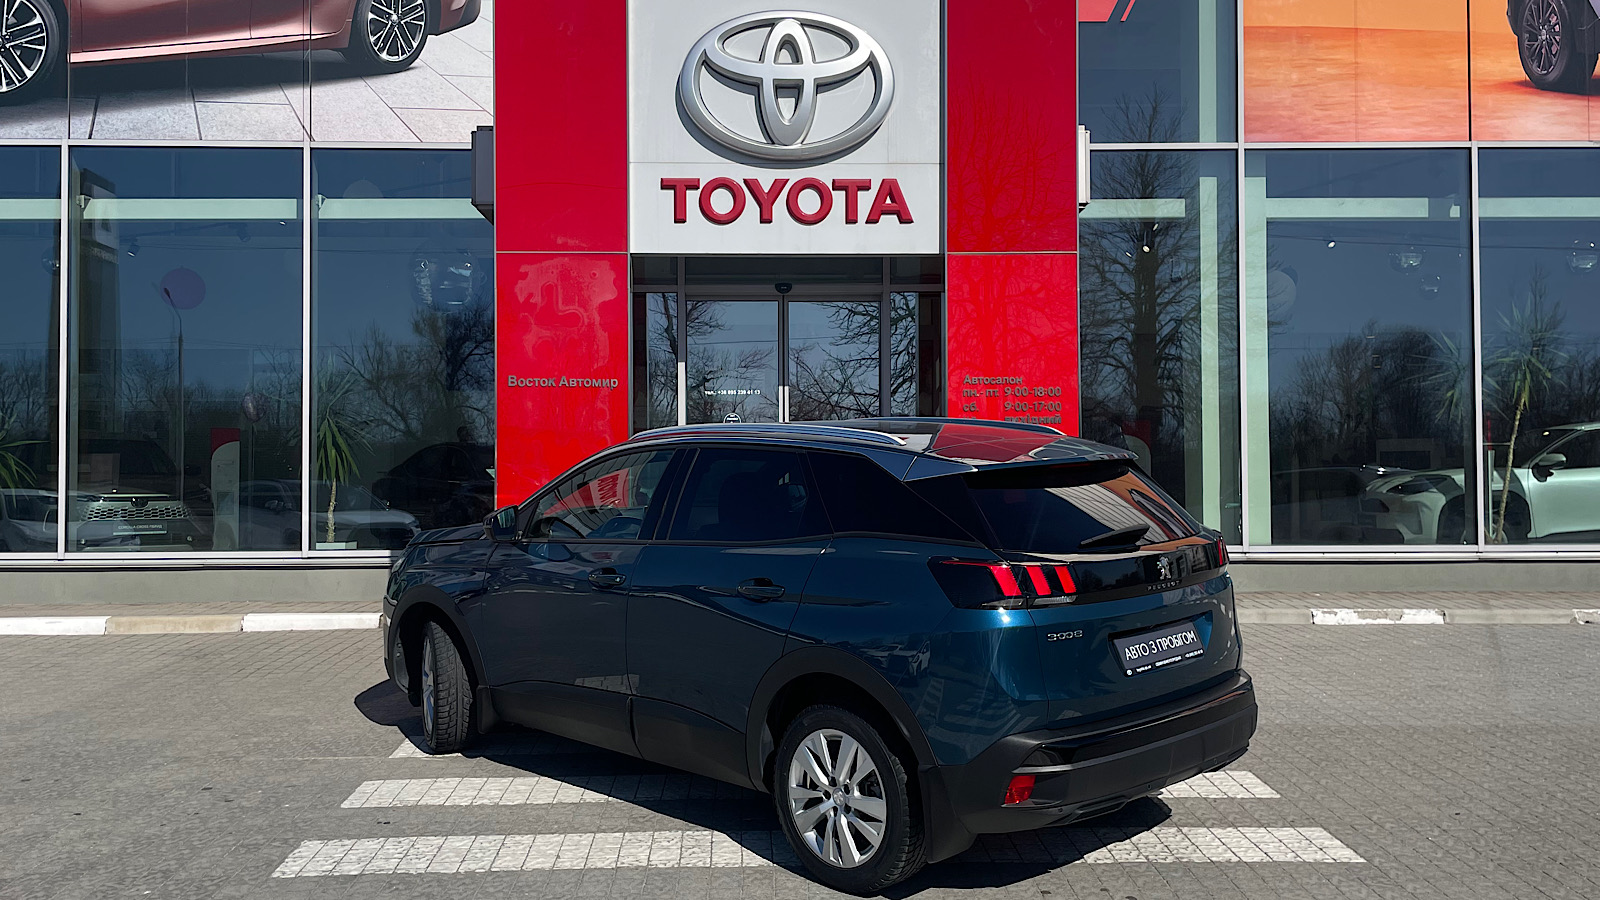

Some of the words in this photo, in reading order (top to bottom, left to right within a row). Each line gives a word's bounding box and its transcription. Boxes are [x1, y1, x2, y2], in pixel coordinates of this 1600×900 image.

[660, 177, 914, 226] TOYOTA
[507, 375, 556, 387] Восток
[558, 375, 619, 391] Автомир
[963, 375, 1023, 385] Автосалон
[1004, 386, 1062, 397] 9:00-18:00
[963, 402, 979, 412] сб.
[1004, 401, 1062, 412] 9:00-17:00
[1147, 580, 1180, 591] PEUGEOT
[1047, 629, 1083, 642] 3008
[1124, 643, 1150, 661] АВТО
[1155, 630, 1197, 652] ПРОБІГОМ
